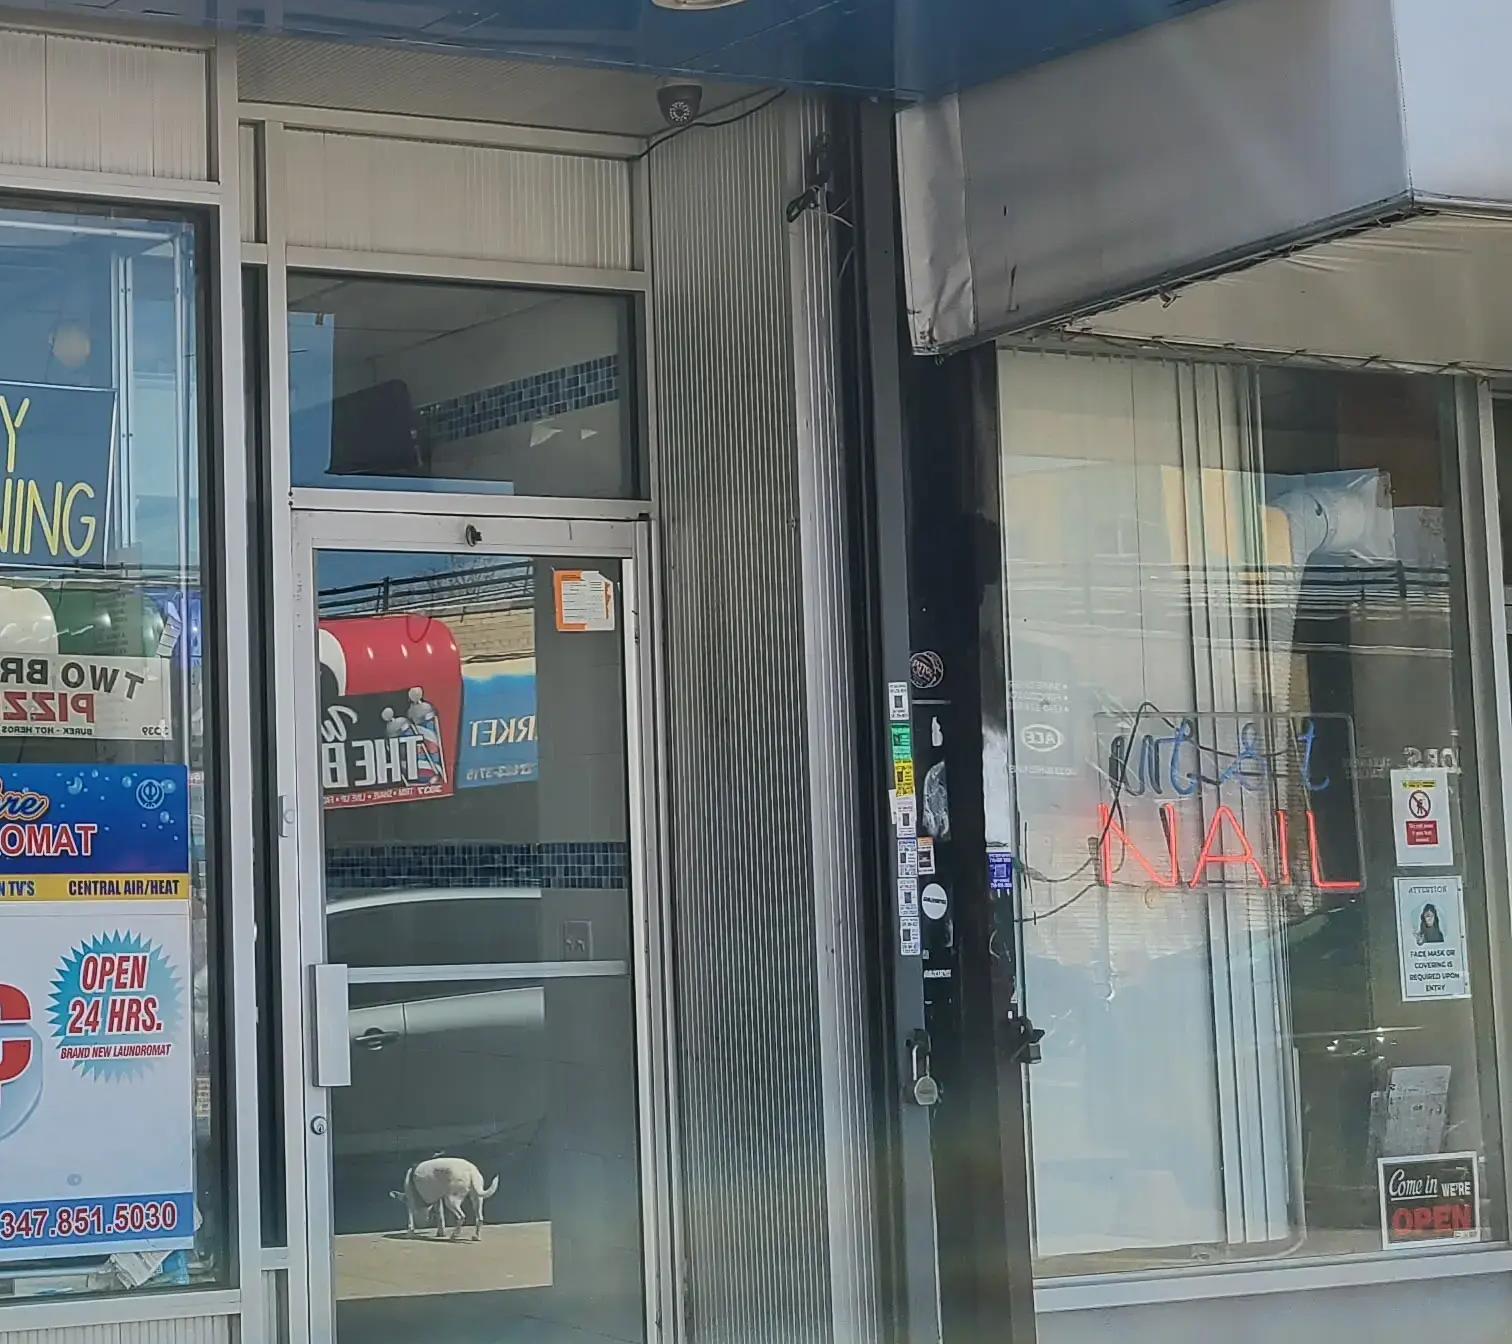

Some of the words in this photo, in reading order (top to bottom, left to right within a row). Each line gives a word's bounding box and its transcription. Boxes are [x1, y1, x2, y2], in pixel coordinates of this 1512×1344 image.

[1097, 802, 1362, 889] NAIL
[68, 880, 123, 896] CENTRAL
[123, 879, 180, 896] AIR/HEAT
[80, 953, 149, 993] OPEN
[66, 996, 103, 1036] 24
[105, 995, 164, 1035] HRS.
[60, 1046, 91, 1060] BRAND
[91, 1045, 113, 1059] NEW
[113, 1043, 172, 1058] LAUNDROMAT
[1388, 1168, 1423, 1198] Come
[1424, 1174, 1438, 1195] in
[1441, 1181, 1472, 1197] WE'RE
[1391, 1204, 1473, 1235] OPEN
